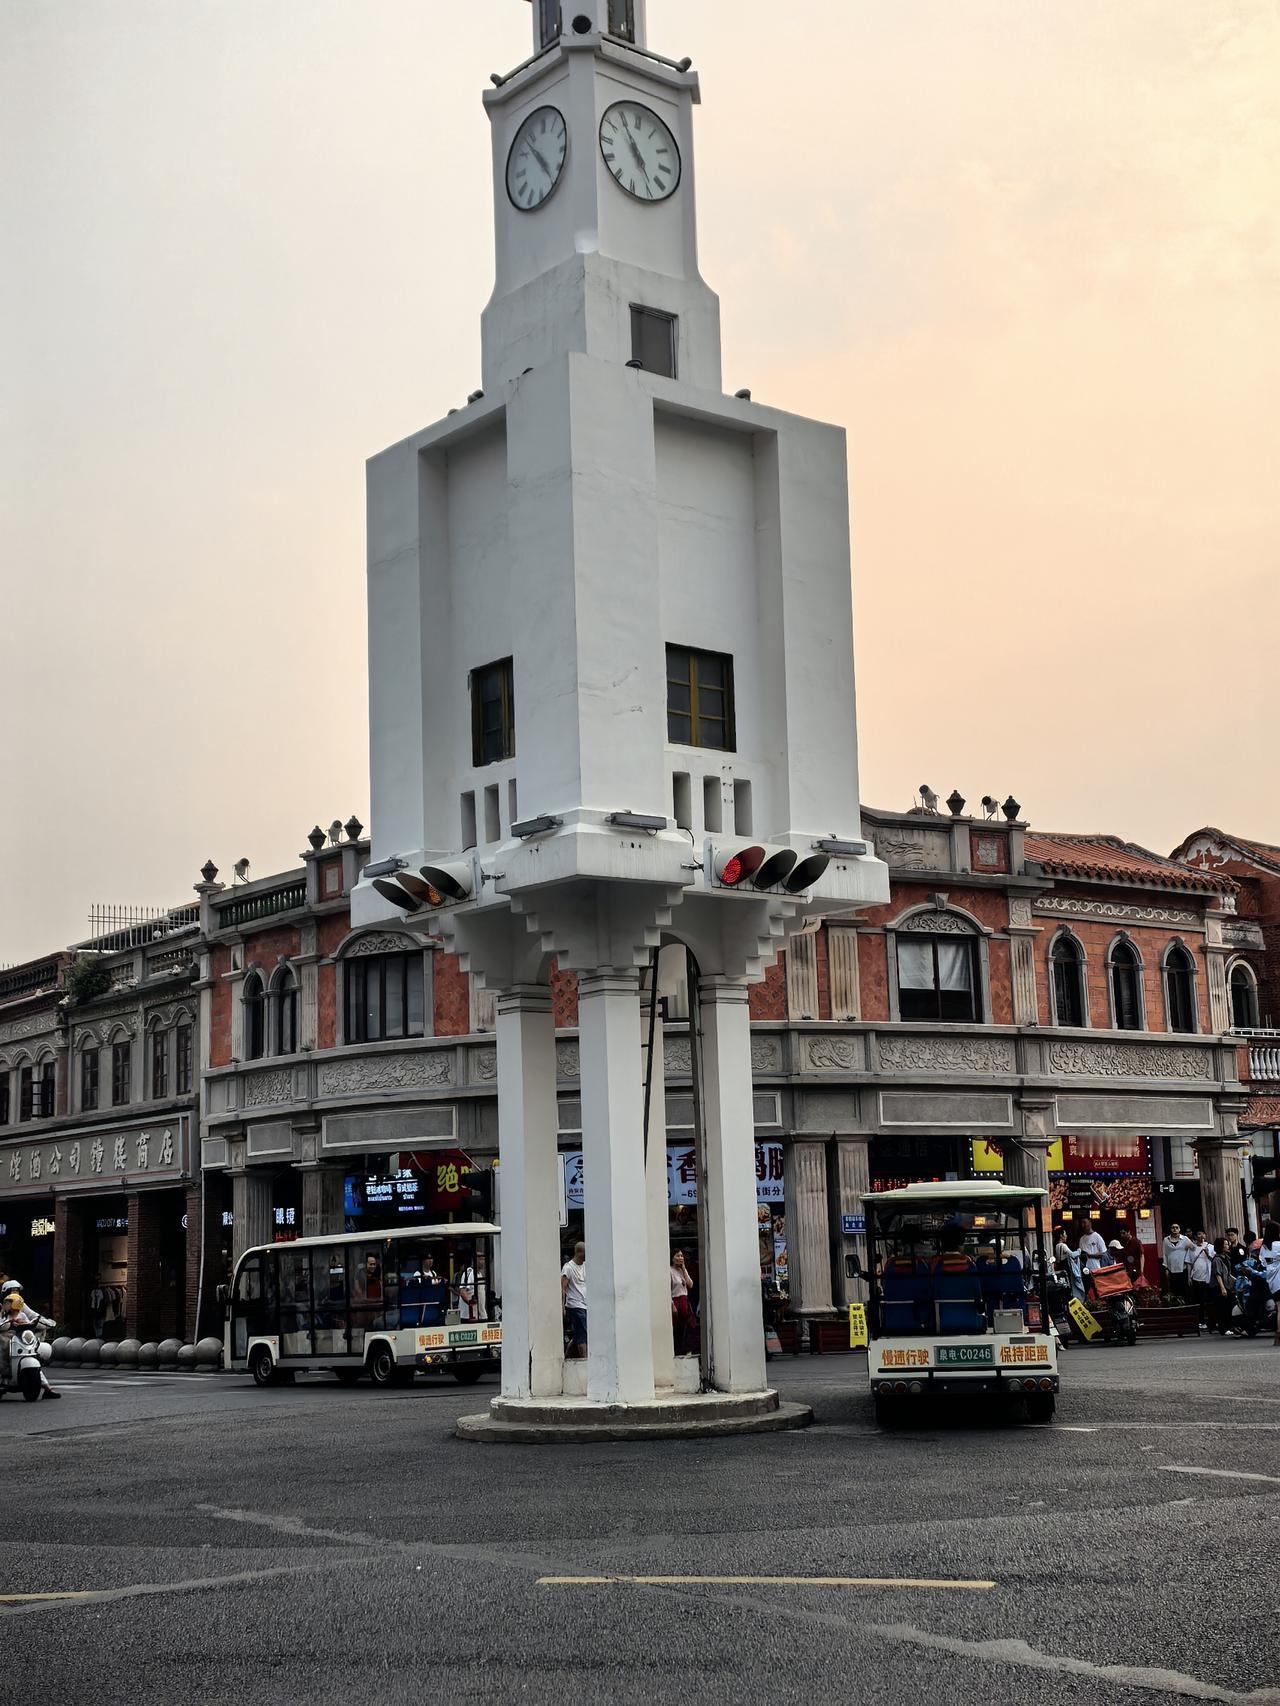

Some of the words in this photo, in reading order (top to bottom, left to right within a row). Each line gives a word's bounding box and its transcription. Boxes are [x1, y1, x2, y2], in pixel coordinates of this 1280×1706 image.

[757, 1186, 785, 1196] 街分
[273, 1207, 295, 1225] 眼镜
[999, 1344, 1049, 1363] 保持距离
